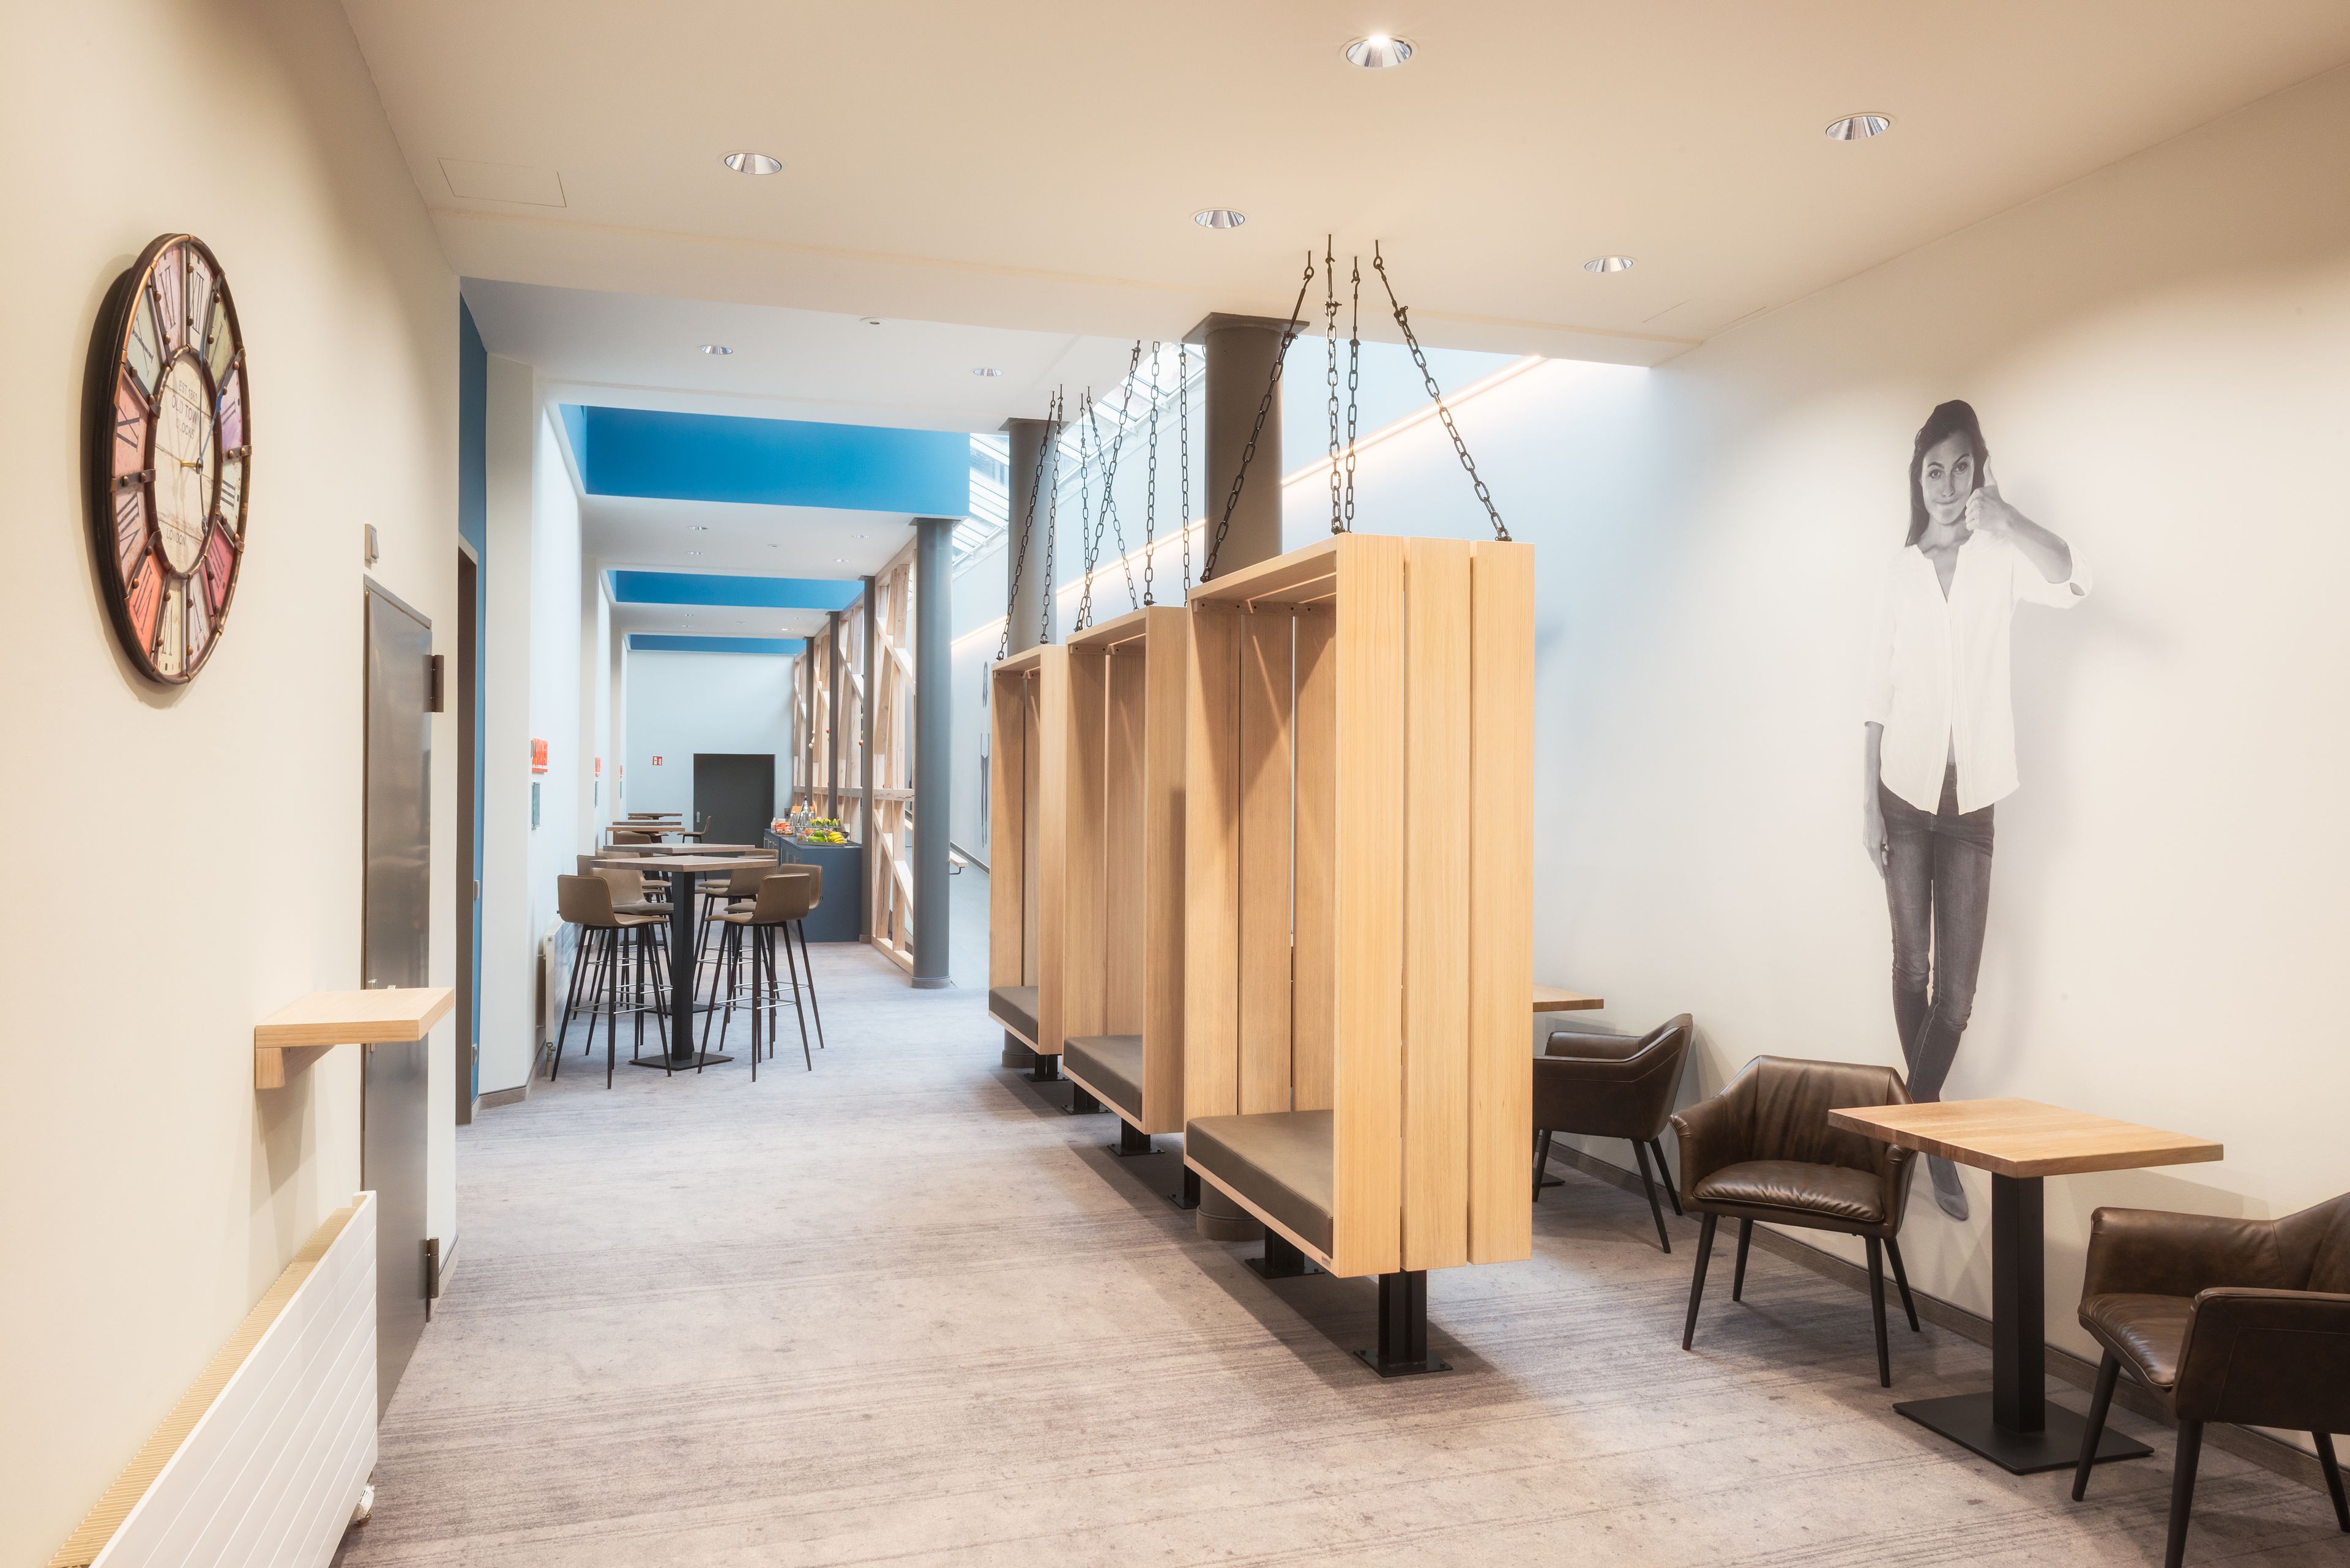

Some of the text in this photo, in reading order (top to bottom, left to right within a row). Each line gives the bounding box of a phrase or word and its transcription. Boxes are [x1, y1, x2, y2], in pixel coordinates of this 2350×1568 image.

[132, 313, 154, 377] X
[179, 380, 187, 395] EST
[172, 395, 184, 414] OLD
[166, 528, 186, 547] LONDON
